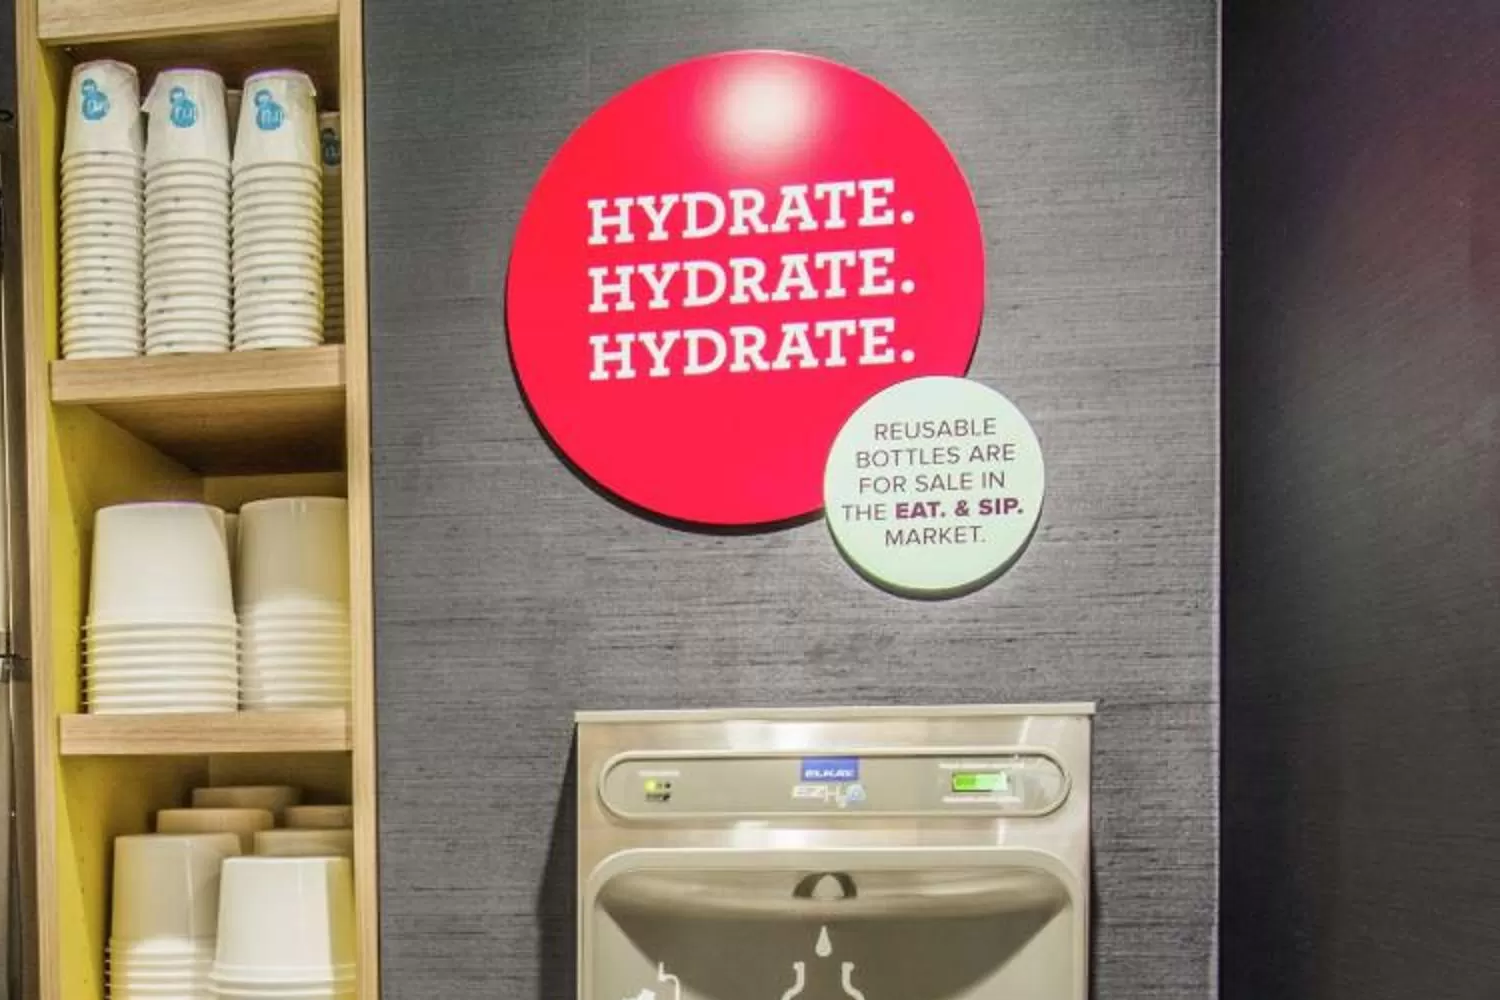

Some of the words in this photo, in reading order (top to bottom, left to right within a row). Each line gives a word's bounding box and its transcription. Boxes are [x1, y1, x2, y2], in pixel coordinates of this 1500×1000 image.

[587, 178, 916, 246] HYDRATE.
[587, 247, 916, 314] HYDRATE.
[588, 316, 916, 381] HYDRATE.
[874, 417, 997, 441] REUSABLE
[856, 446, 961, 469] BOTTLES
[969, 443, 1016, 463] ARE
[858, 475, 907, 495] FOR
[915, 471, 973, 492] SALE
[981, 469, 1006, 489] IN
[842, 503, 887, 522] THE
[895, 501, 946, 520] EAT.
[954, 499, 971, 517] &
[978, 497, 1024, 516] SIP.
[884, 525, 987, 548] MARKET.
